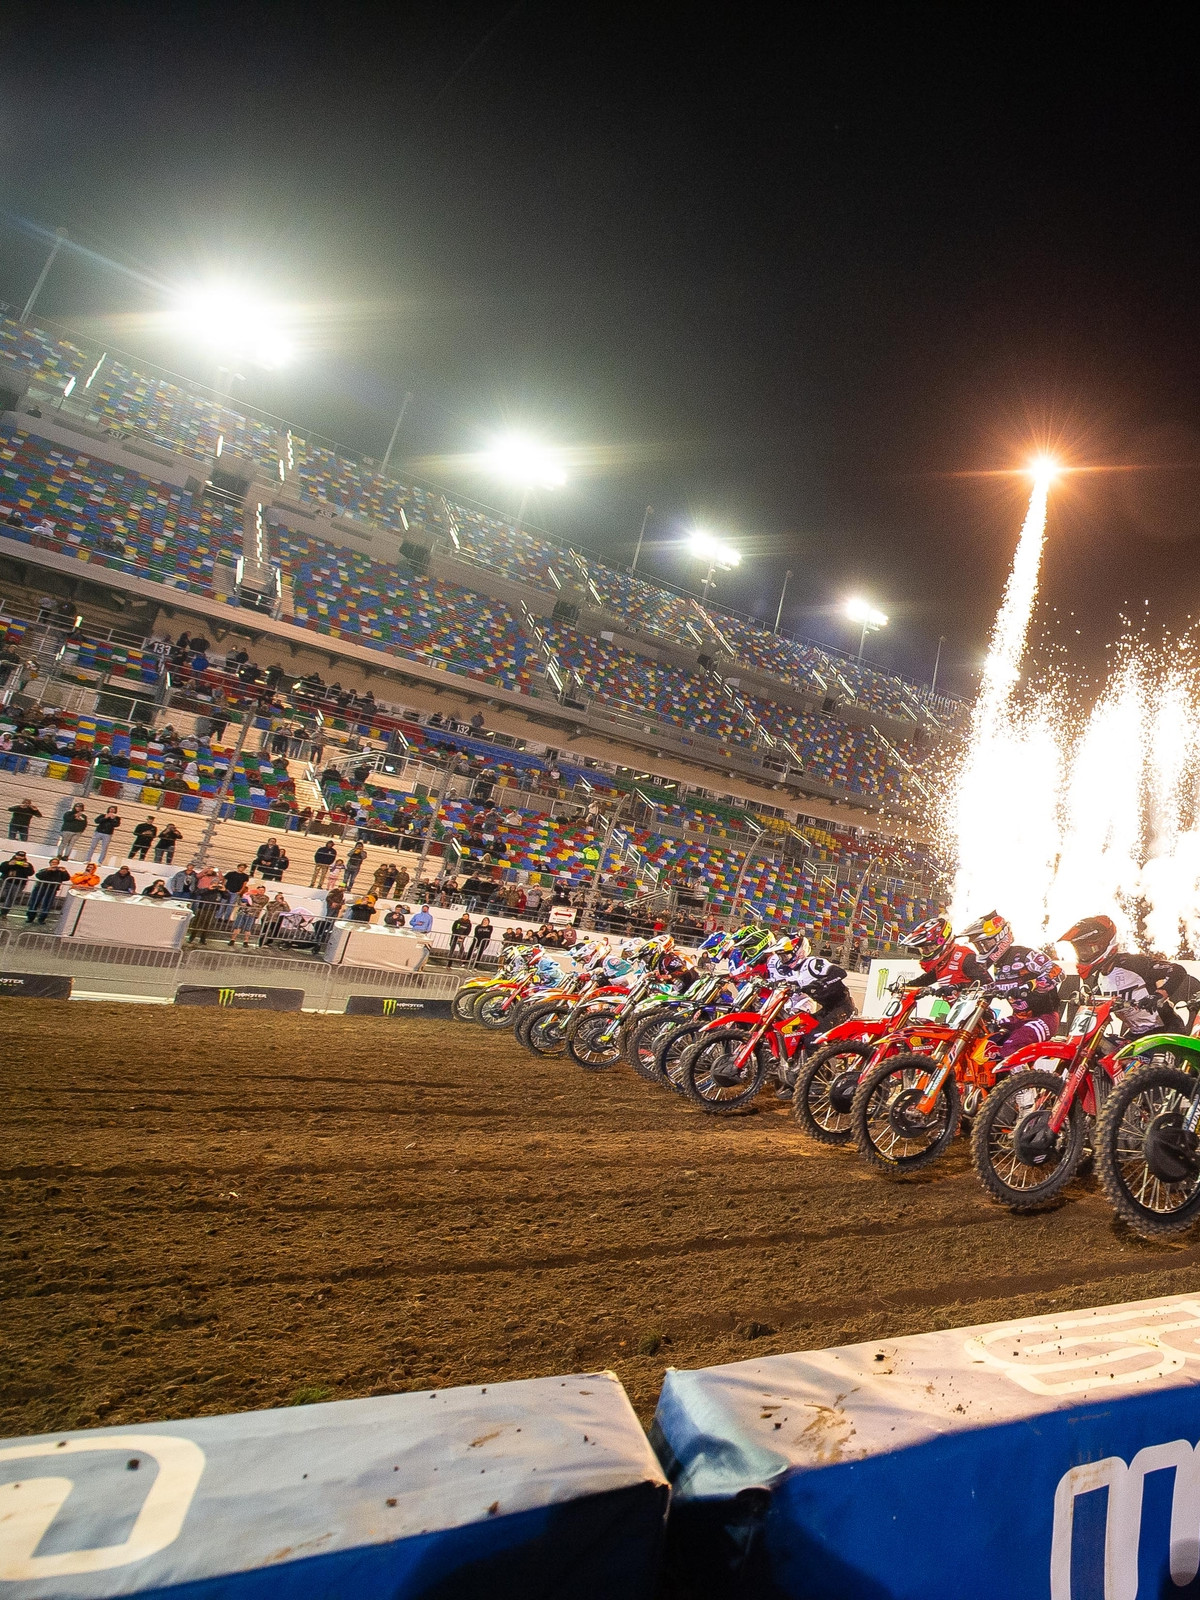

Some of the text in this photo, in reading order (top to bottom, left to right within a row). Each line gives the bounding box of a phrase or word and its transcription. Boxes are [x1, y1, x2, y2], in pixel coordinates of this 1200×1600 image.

[153, 642, 171, 655] 133
[456, 724, 470, 735] 132
[653, 776, 662, 785] 131
